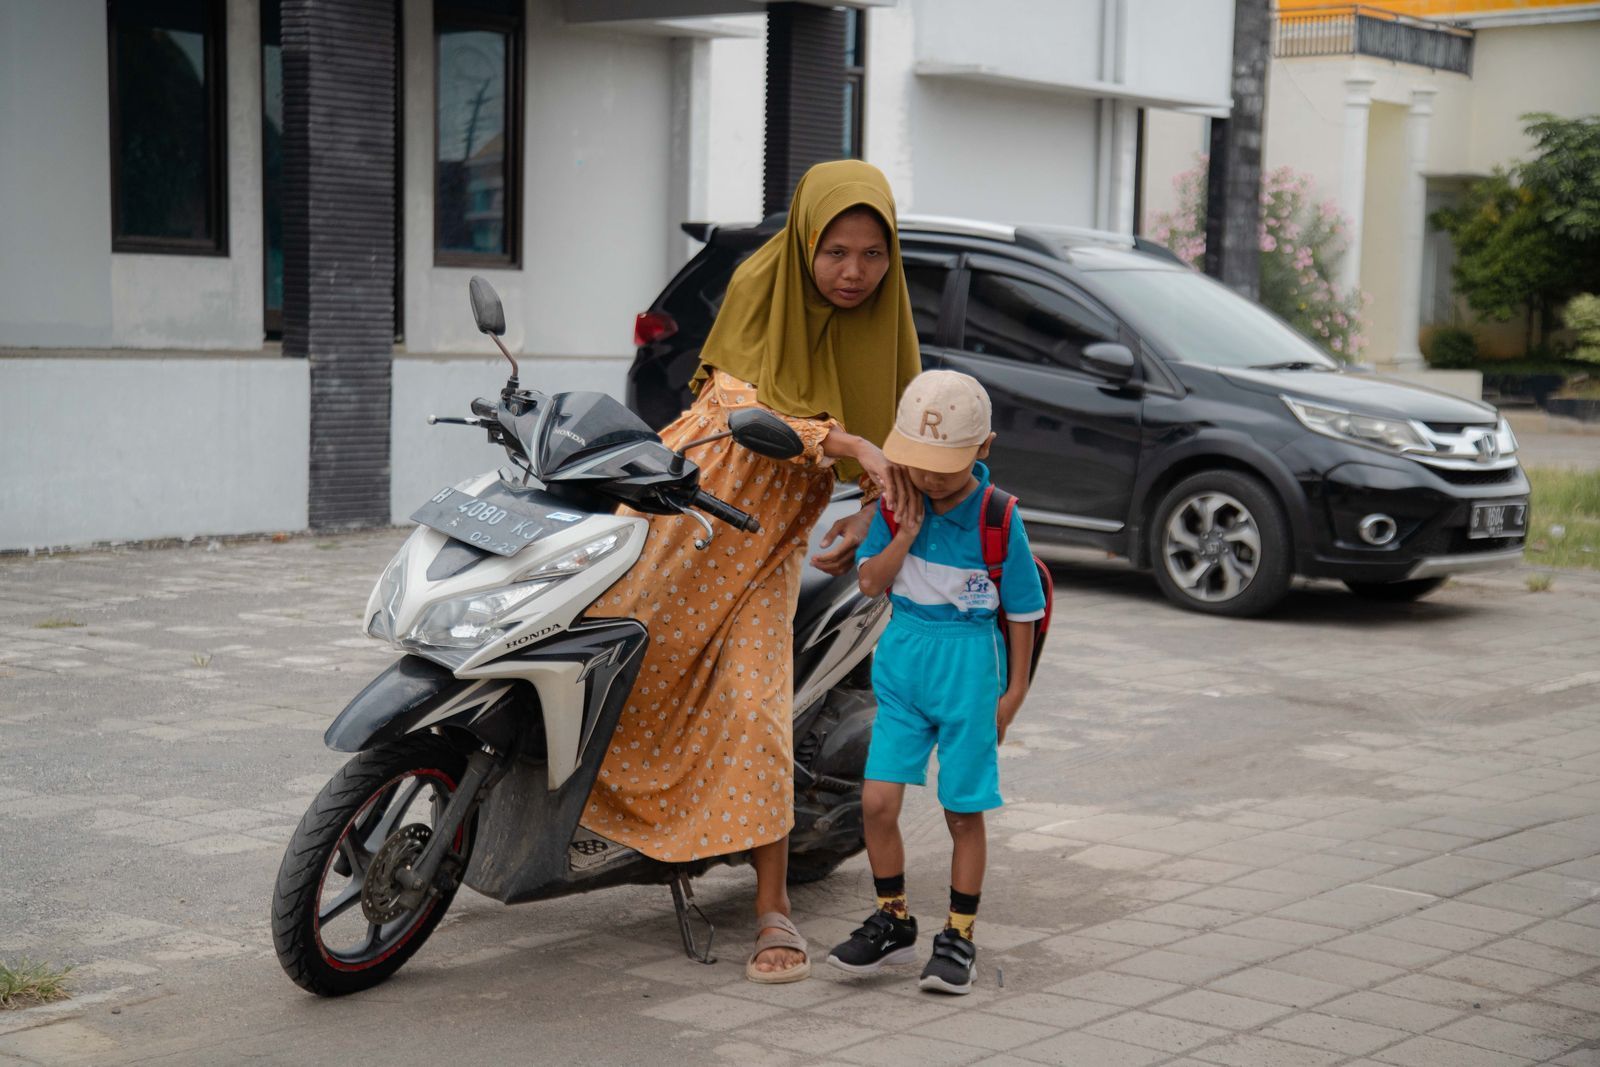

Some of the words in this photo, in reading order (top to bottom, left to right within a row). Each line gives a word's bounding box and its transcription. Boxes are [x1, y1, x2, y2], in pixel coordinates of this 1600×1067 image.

[552, 429, 586, 447] HONDA
[919, 410, 948, 440] R.
[457, 499, 508, 526] 4080
[510, 519, 544, 540] KJ
[504, 623, 563, 650] HONDA
